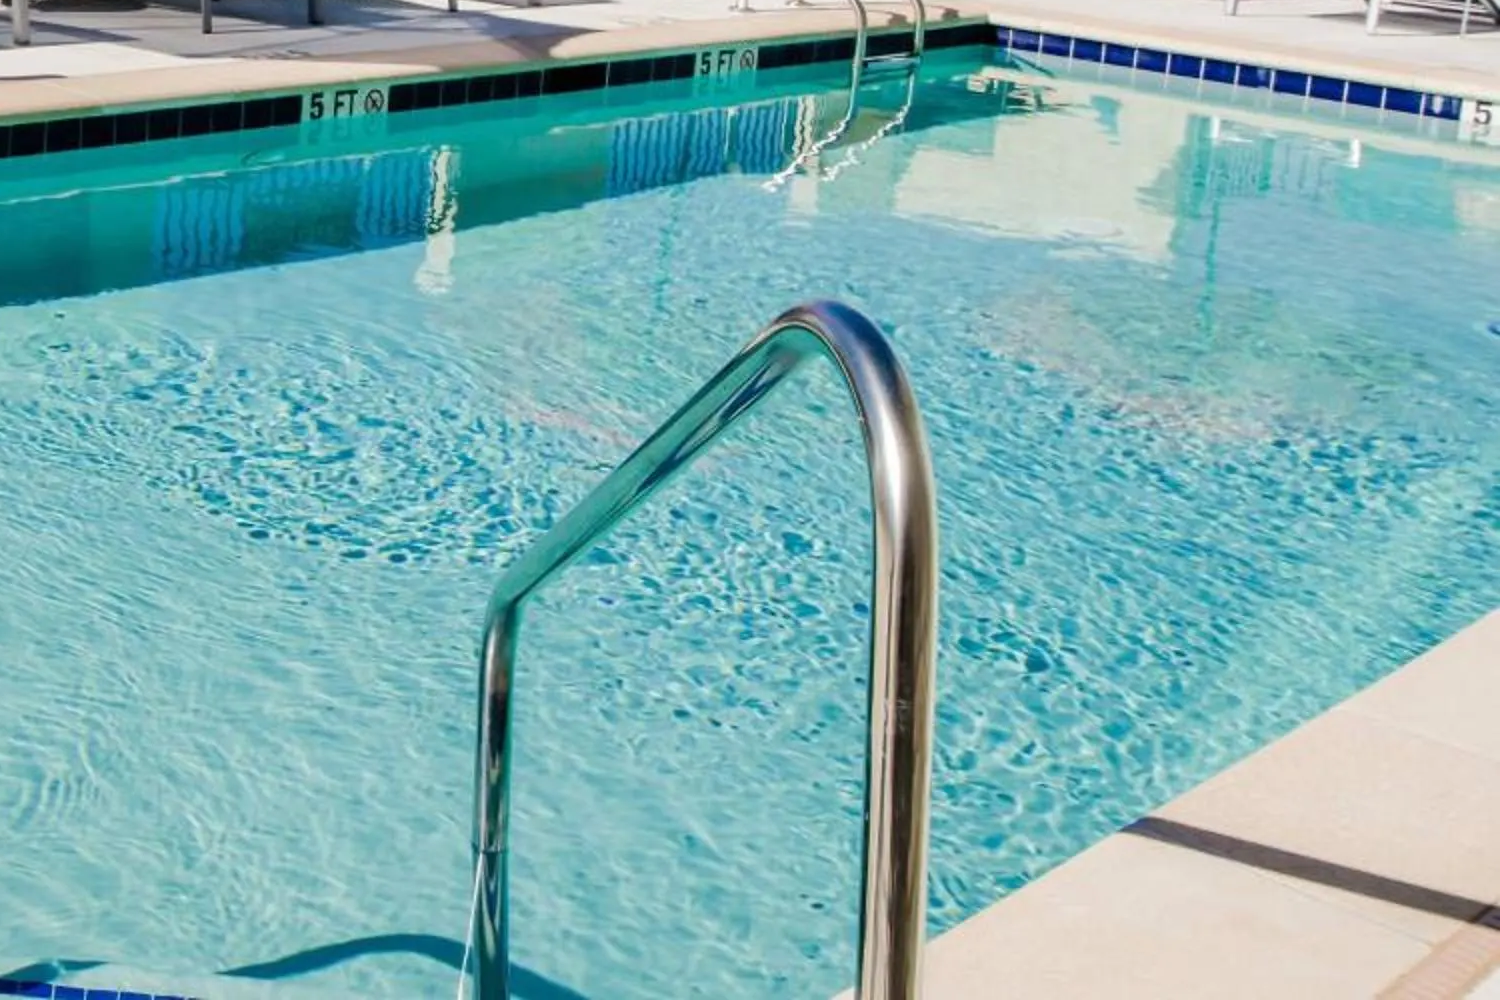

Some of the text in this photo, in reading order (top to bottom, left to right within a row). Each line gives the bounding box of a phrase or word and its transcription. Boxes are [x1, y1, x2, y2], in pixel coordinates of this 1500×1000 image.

[700, 49, 737, 75] 5 FT
[309, 89, 359, 120] 5 FT
[1473, 99, 1493, 126] 5
